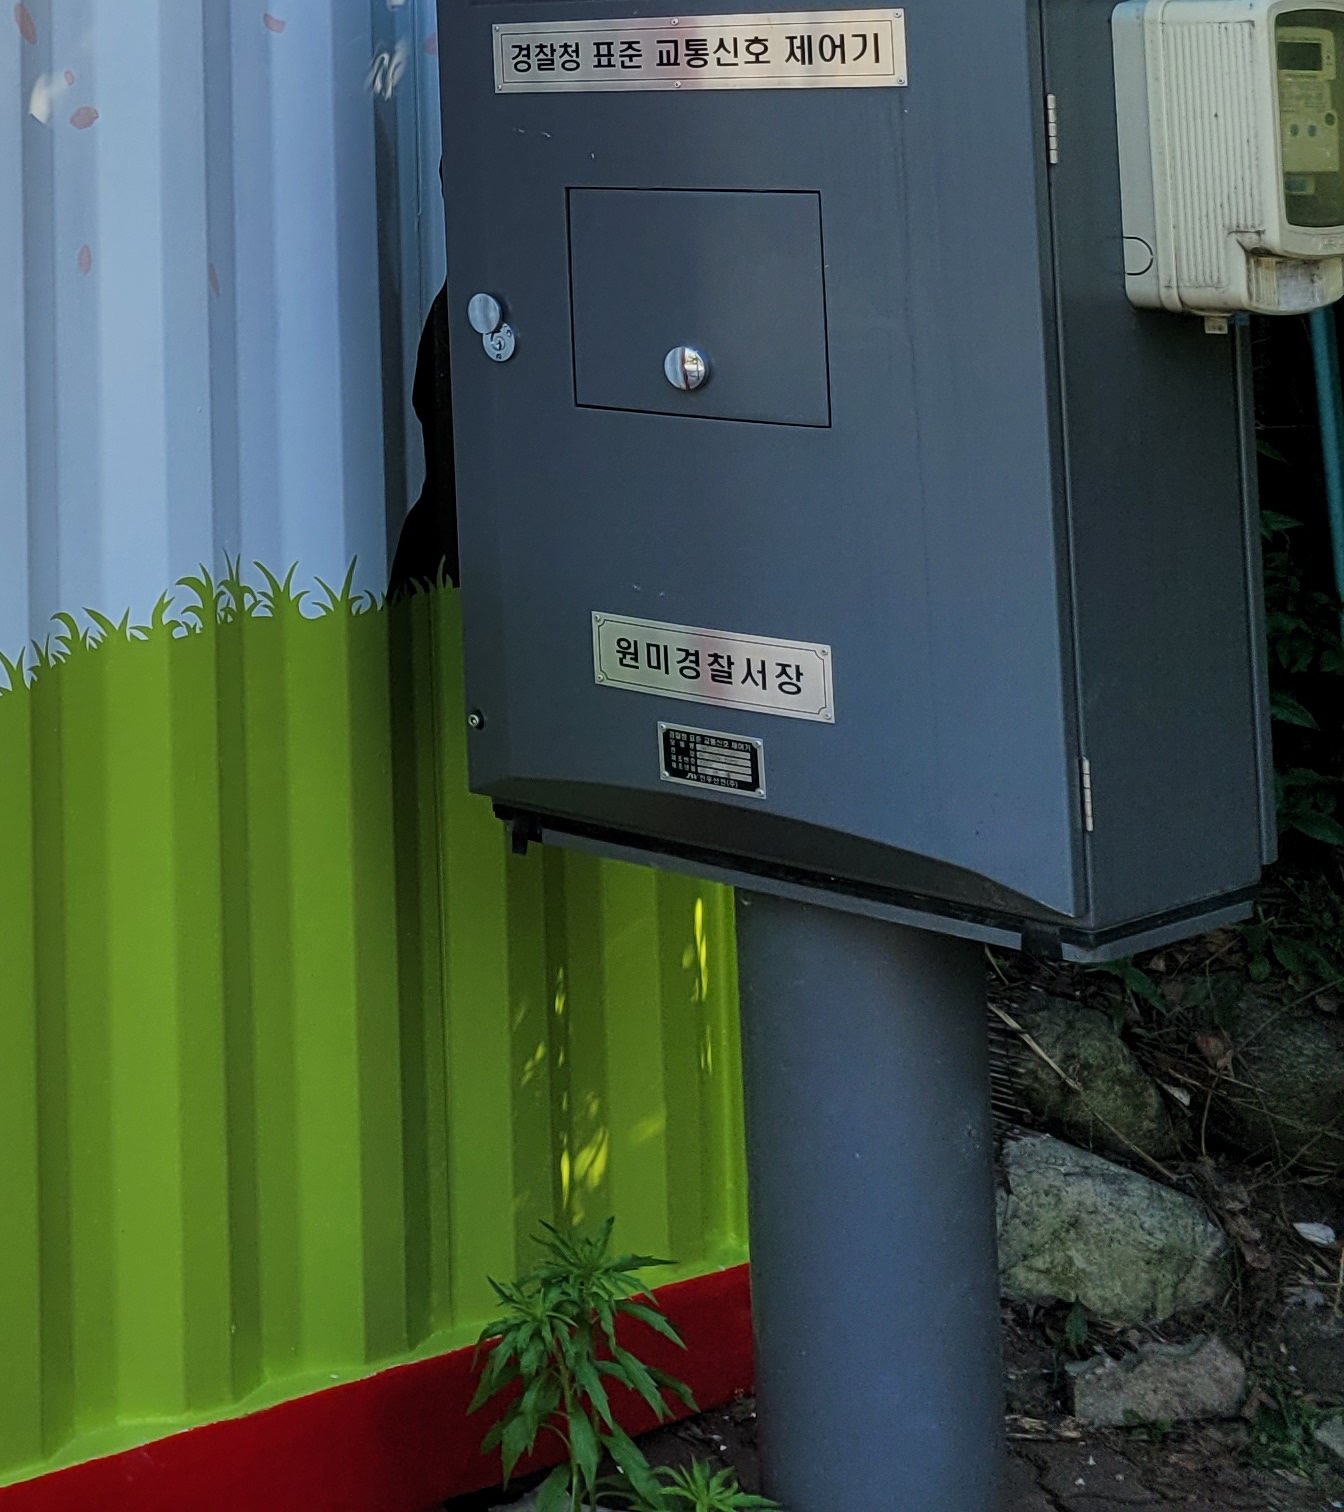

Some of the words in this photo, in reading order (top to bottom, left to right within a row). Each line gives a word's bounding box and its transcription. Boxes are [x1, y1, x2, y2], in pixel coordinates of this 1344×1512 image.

[510, 41, 582, 73] 경찰청
[592, 39, 643, 70] 표준
[655, 35, 772, 68] 교통신호
[784, 32, 881, 66] 제어기
[615, 637, 804, 696] 원미경찰서장
